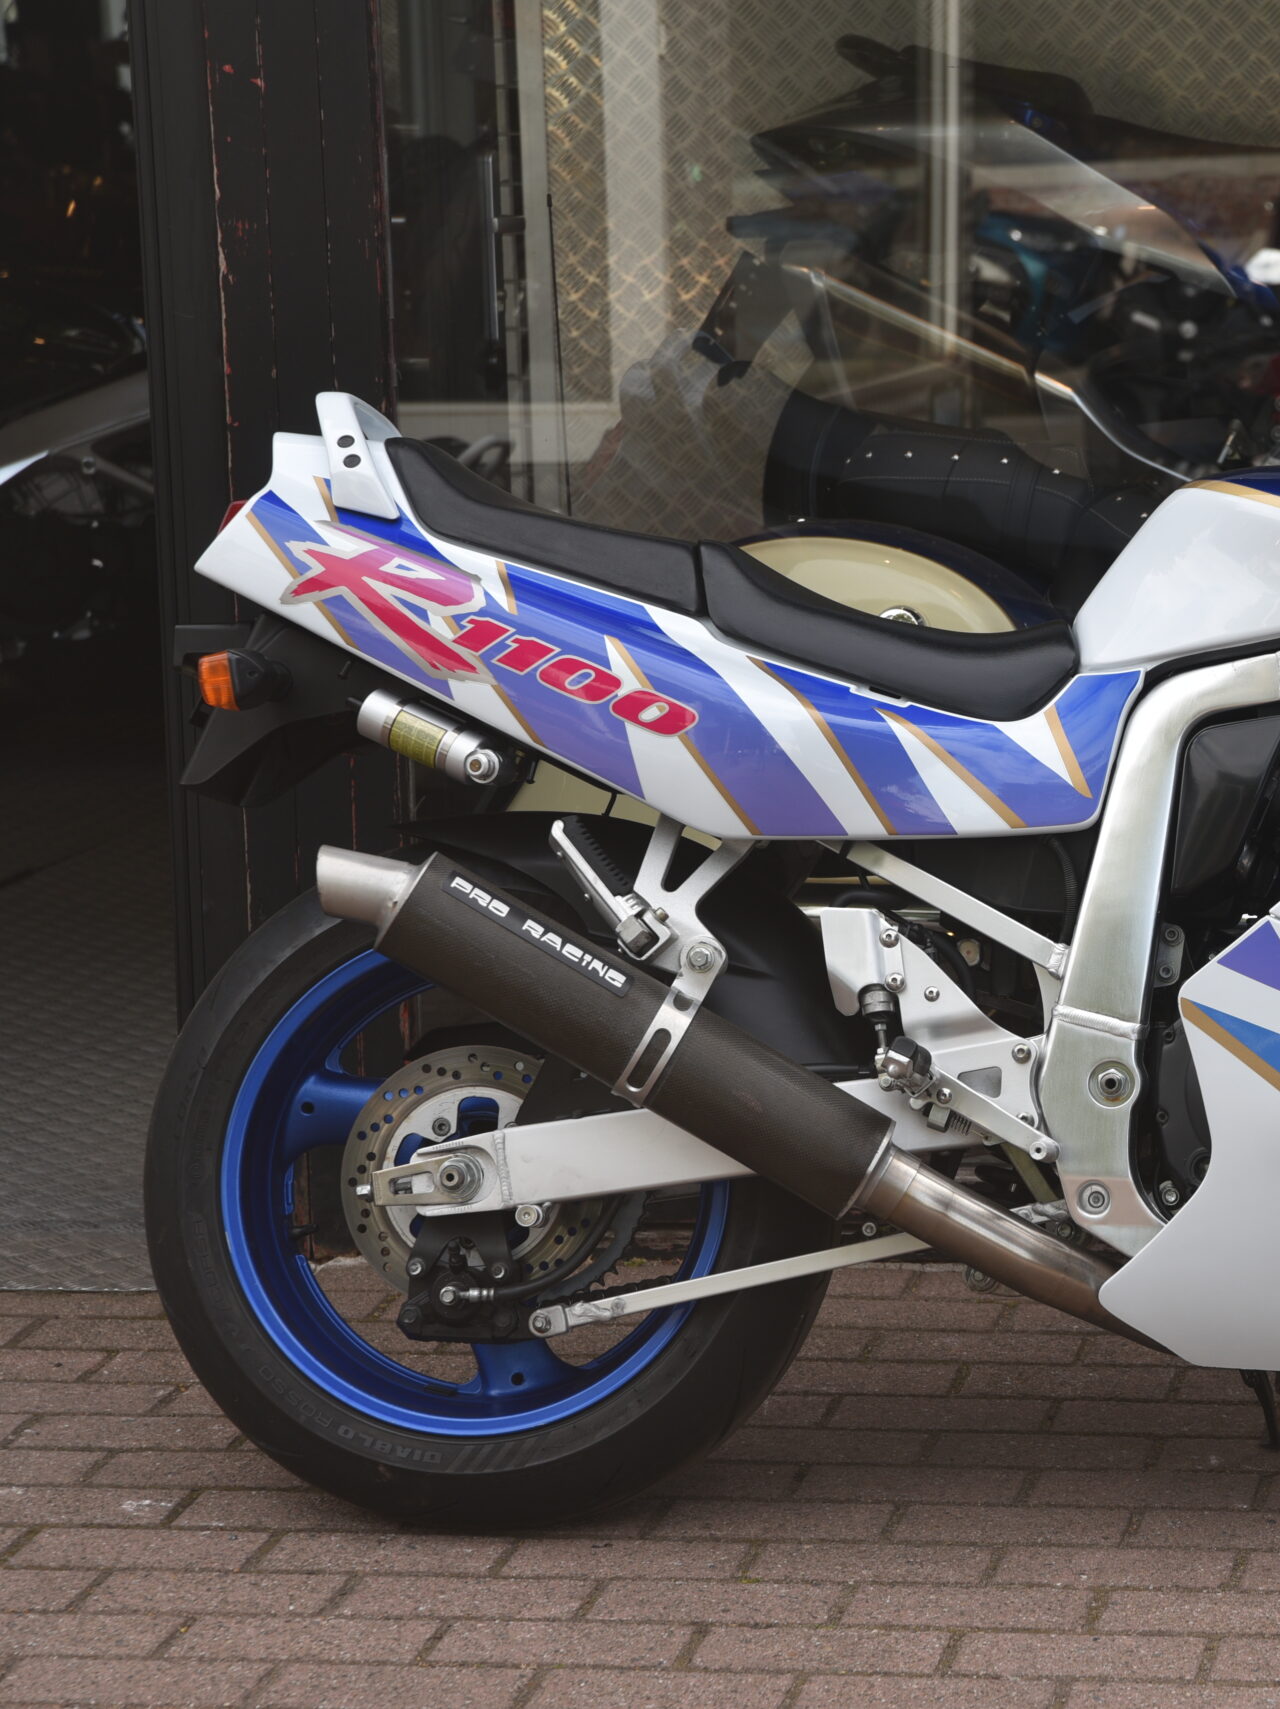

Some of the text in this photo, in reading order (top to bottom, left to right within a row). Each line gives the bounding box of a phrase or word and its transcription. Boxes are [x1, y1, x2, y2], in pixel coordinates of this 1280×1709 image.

[280, 520, 699, 737] R 1100
[450, 876, 627, 988] PRO RACING
[257, 1364, 332, 1429] ROSSO
[336, 1424, 445, 1465] DIABLO
